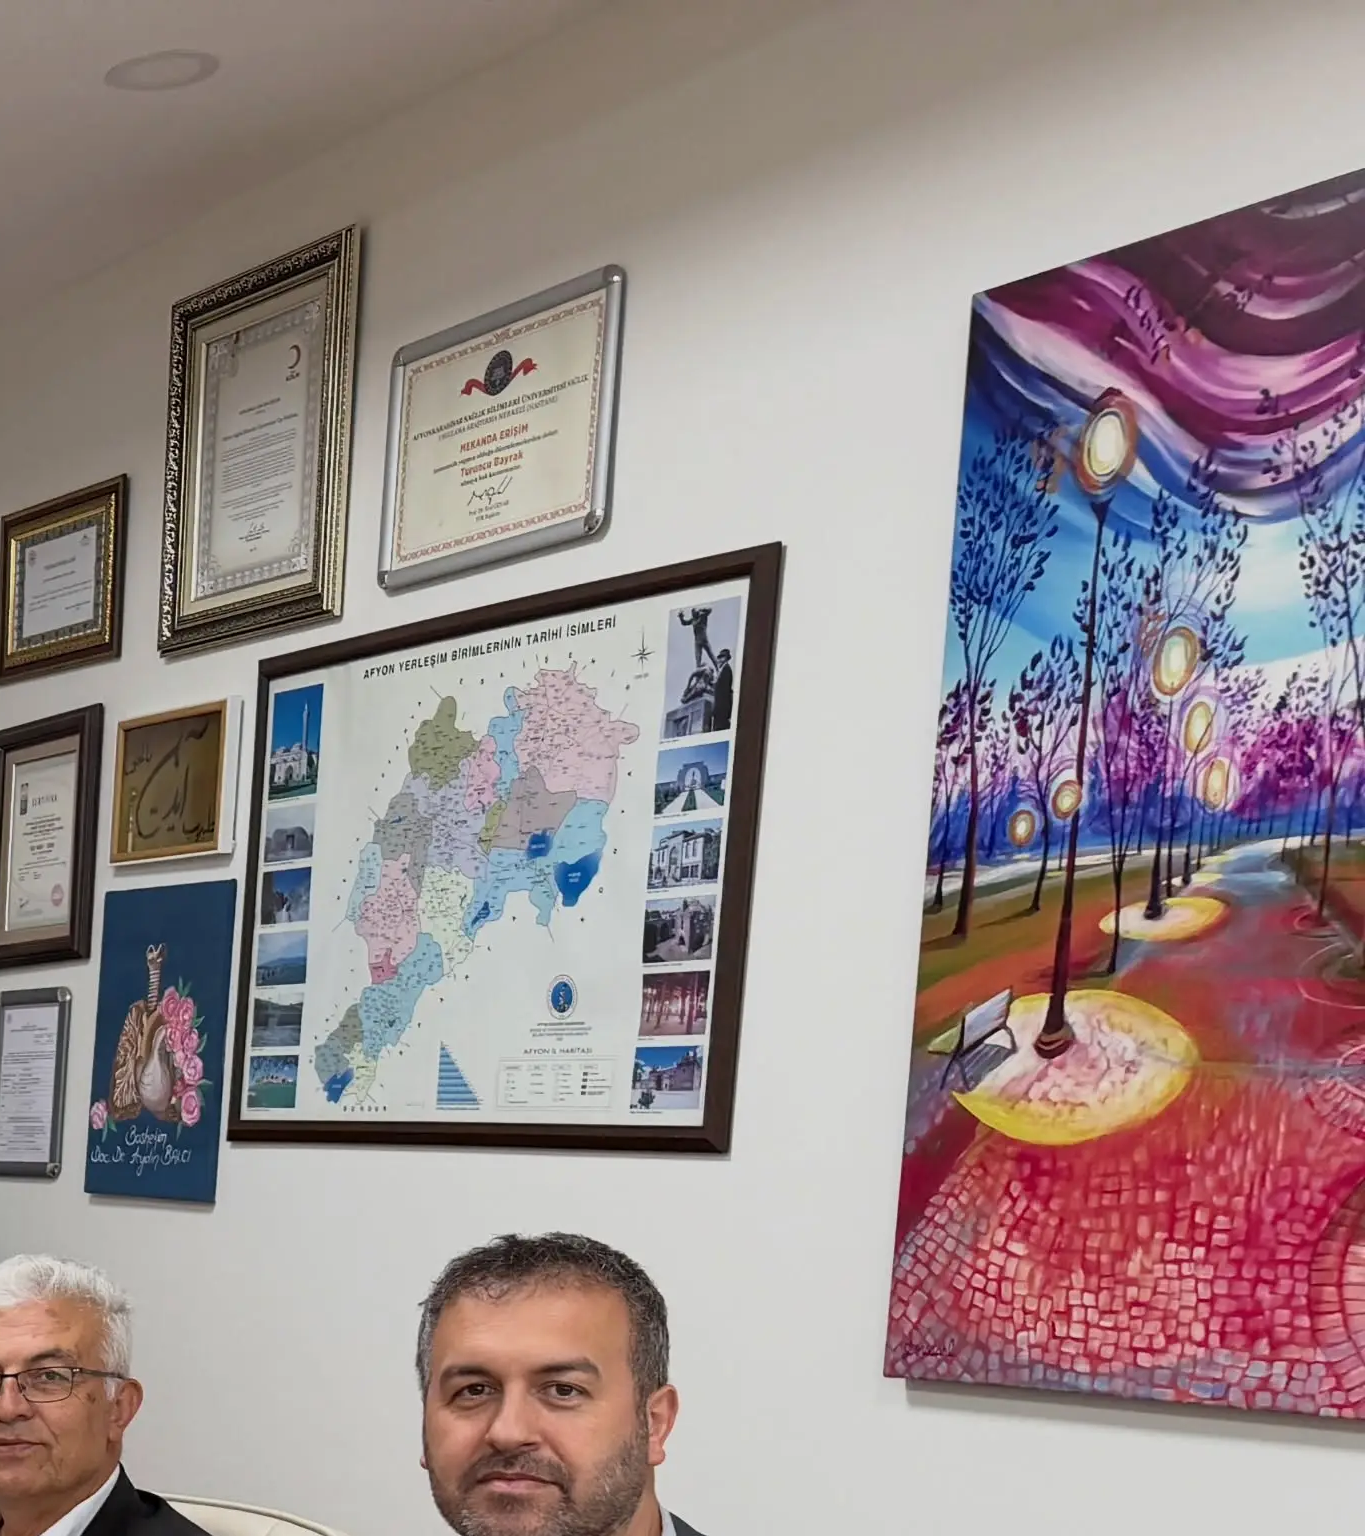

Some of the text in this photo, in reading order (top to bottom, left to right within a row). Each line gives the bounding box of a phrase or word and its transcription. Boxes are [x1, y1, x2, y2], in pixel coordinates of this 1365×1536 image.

[460, 423, 529, 453] MEKANDA ERİŞİM
[460, 458, 492, 478] Turuncu
[493, 450, 524, 469] Bayrak
[362, 614, 617, 680] AFYON YERLEŞİM BİRİMLERİNİN TARİHİ İSİMLERİ
